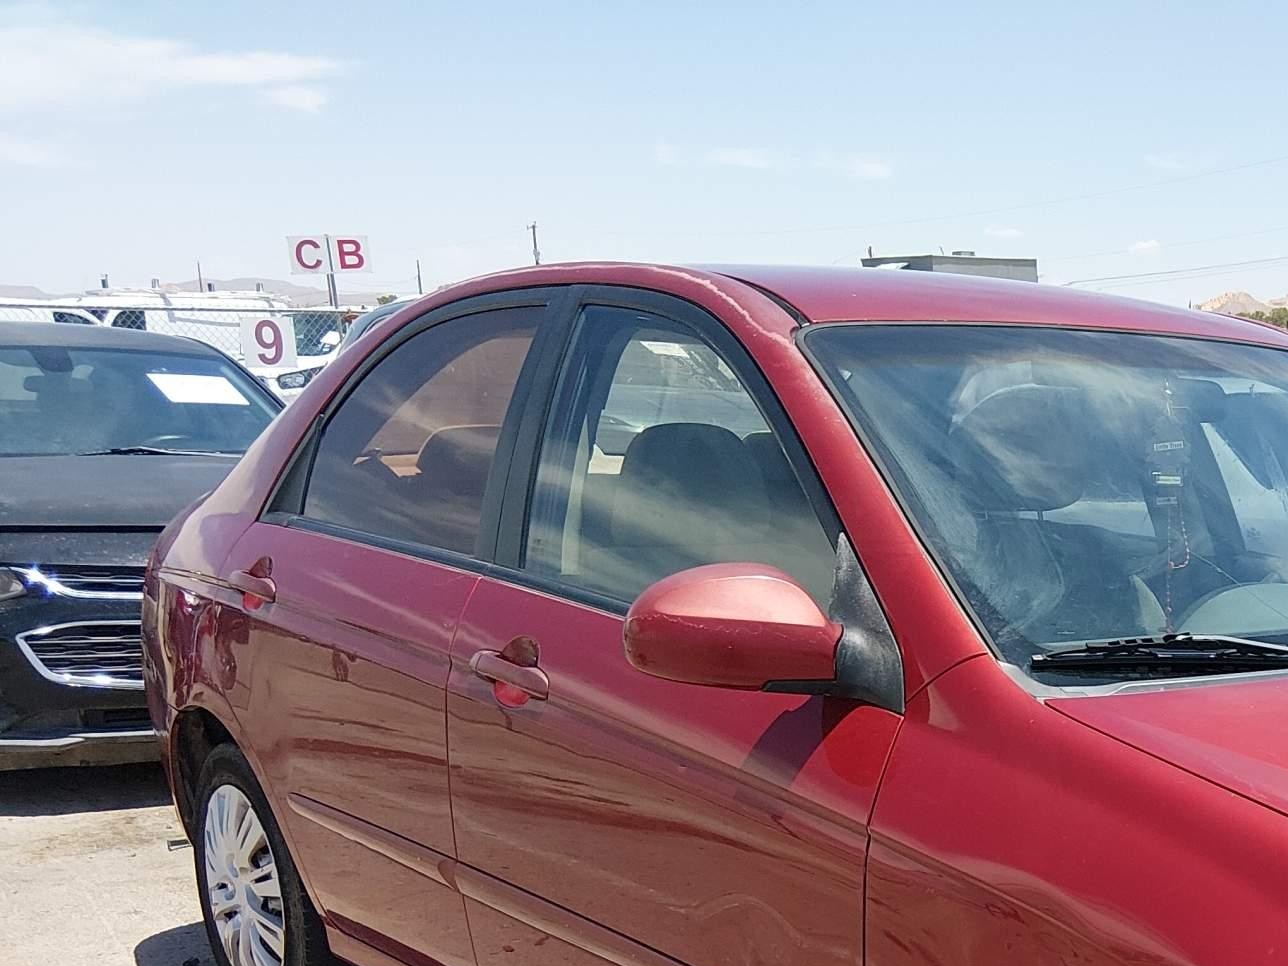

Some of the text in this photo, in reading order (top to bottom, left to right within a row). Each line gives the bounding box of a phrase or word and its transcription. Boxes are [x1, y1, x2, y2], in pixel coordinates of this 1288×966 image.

[295, 239, 323, 270] C
[336, 239, 365, 270] B
[254, 319, 284, 366] 9
